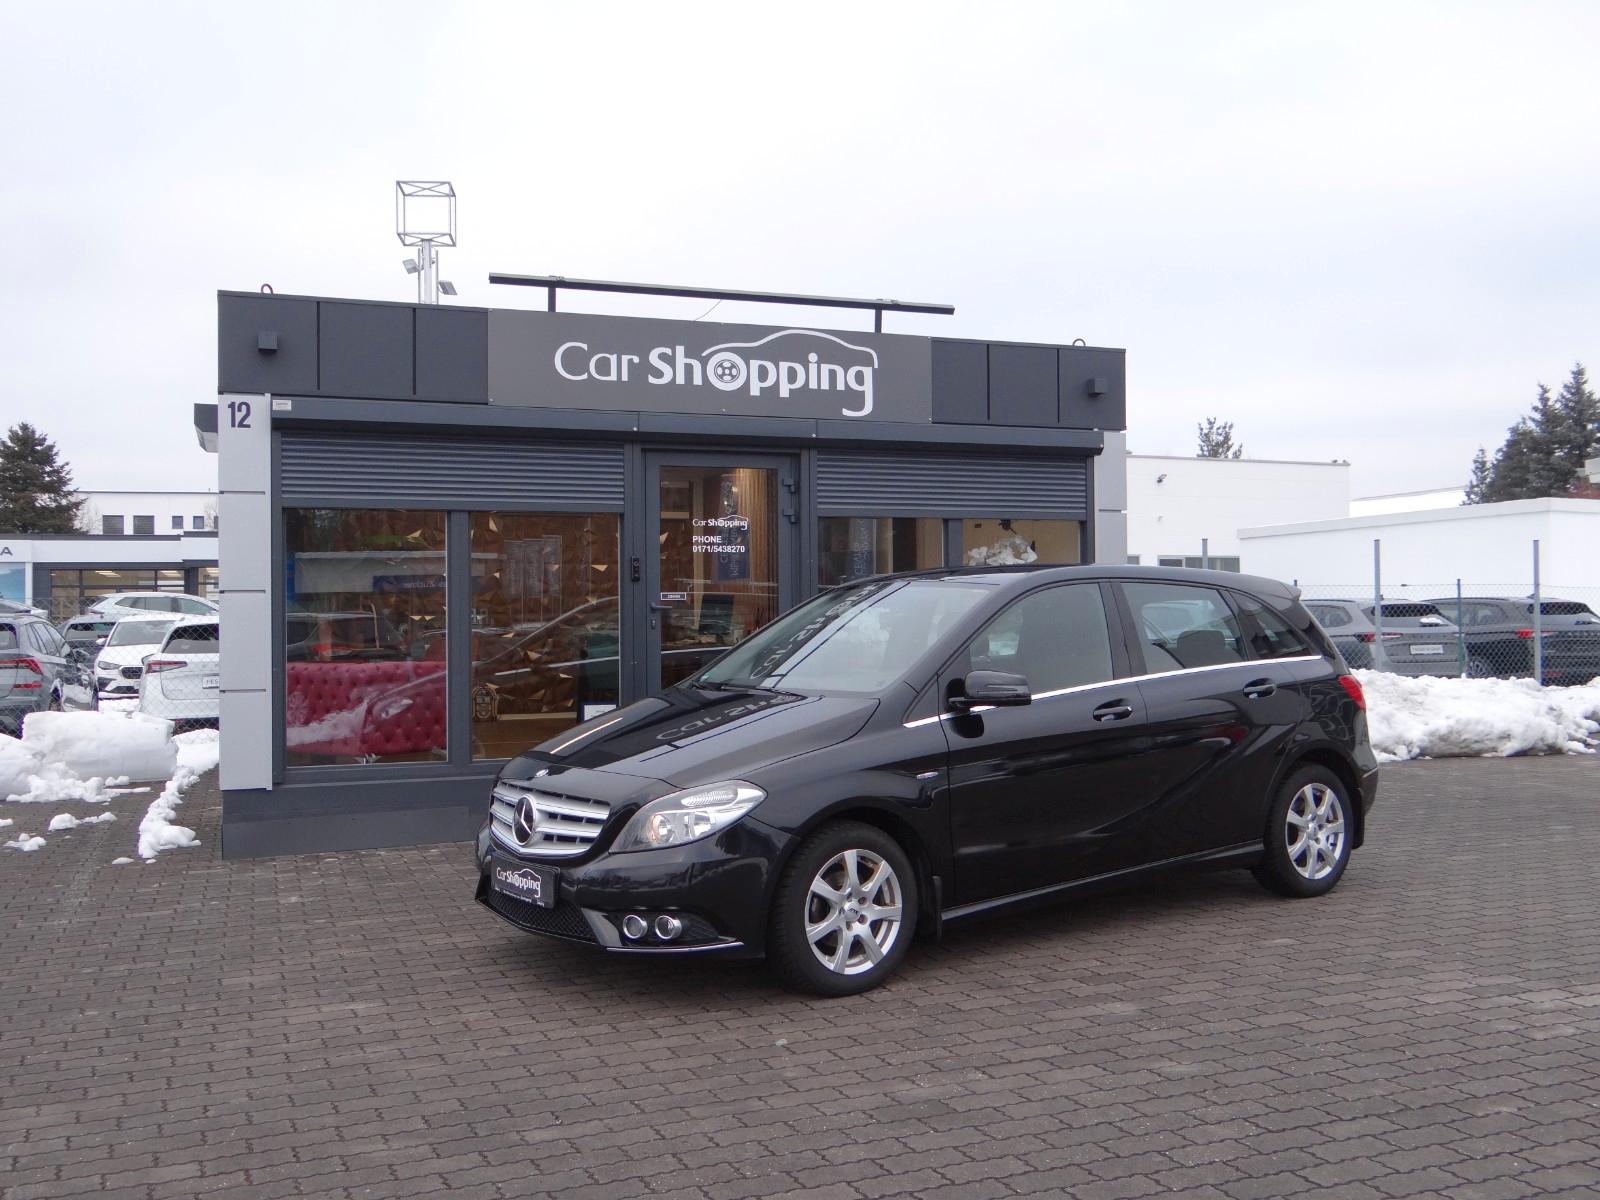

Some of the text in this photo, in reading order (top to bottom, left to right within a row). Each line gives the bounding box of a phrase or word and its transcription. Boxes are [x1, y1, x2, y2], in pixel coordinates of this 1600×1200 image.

[554, 341, 873, 417] Car Shopping
[227, 401, 252, 429] 12
[692, 518, 748, 531] Car Shopping
[692, 535, 722, 543] PHONE
[692, 545, 746, 553] 0171/5438270
[506, 870, 541, 898] Shopping
